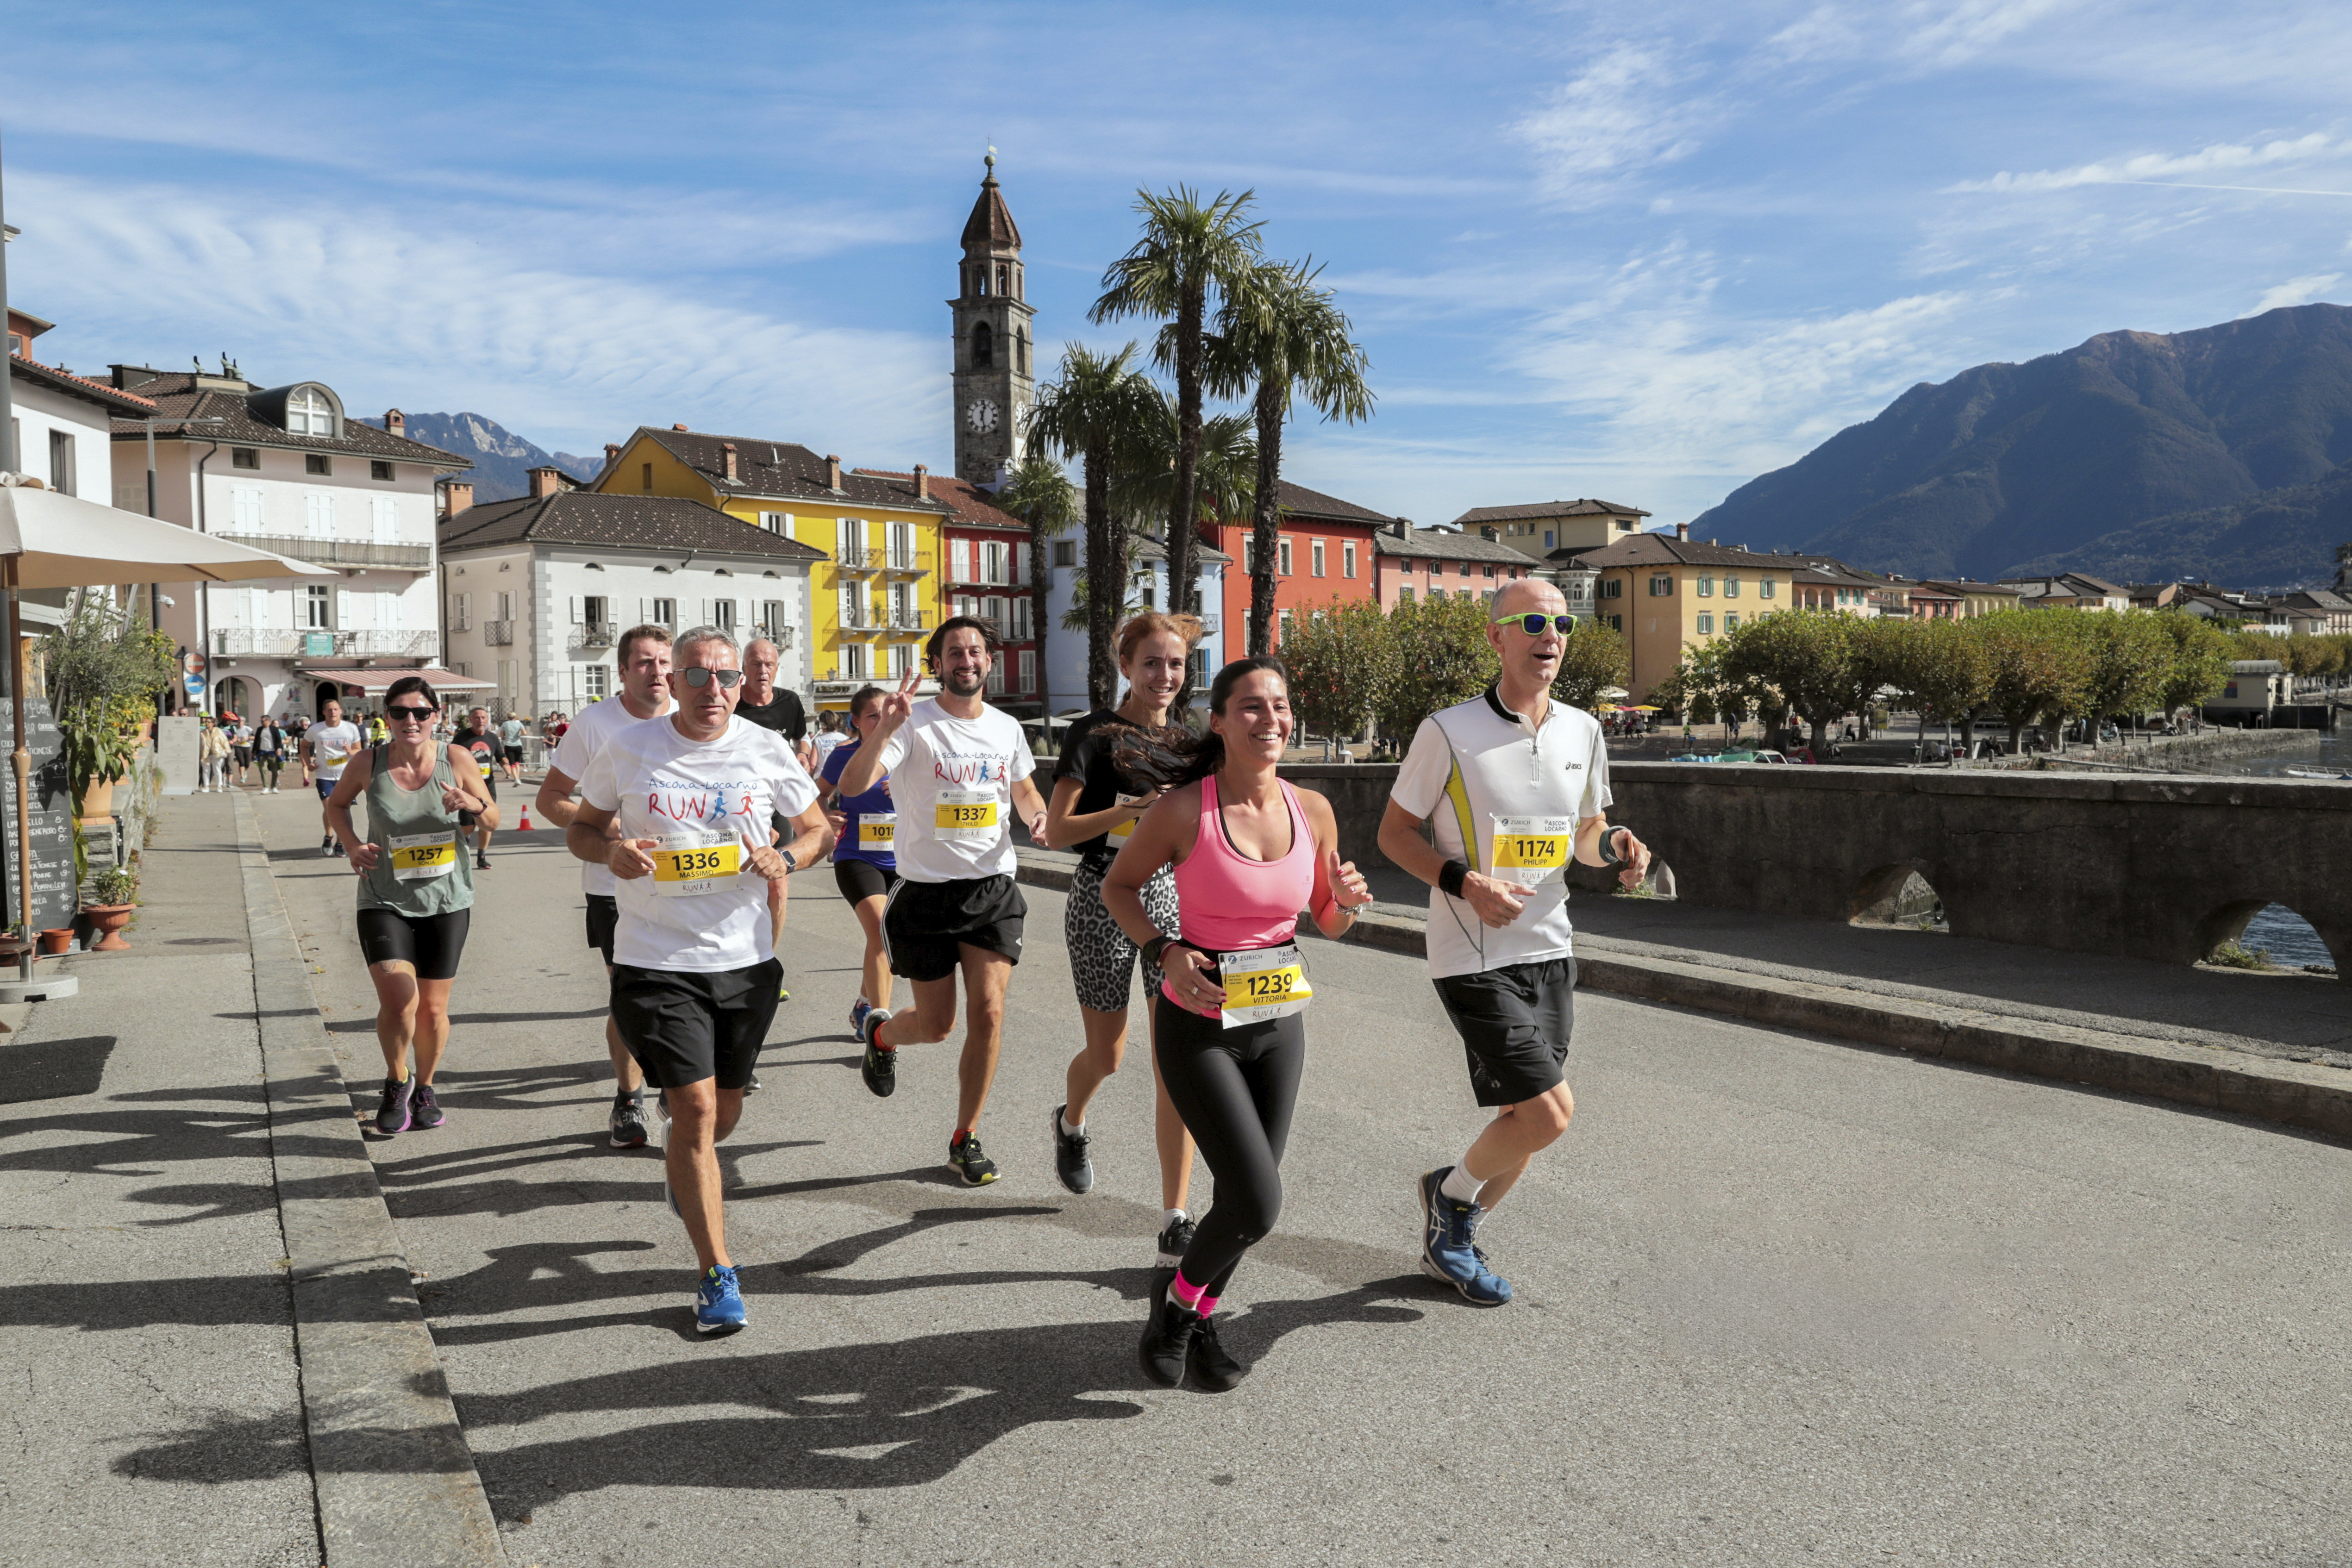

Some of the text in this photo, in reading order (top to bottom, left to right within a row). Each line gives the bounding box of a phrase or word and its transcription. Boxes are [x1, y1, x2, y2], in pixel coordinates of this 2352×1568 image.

[934, 750, 1009, 760] Ascona-Locarno
[935, 762, 976, 784] RUN
[648, 778, 757, 790] Ascona-Locarno
[28, 801, 43, 810] ATER
[649, 792, 706, 820] RUN
[953, 807, 988, 821] 1337
[28, 827, 57, 836] GENEROSO
[409, 847, 443, 861] 1257
[1516, 840, 1555, 857] 1174
[672, 851, 720, 871] 1336
[679, 869, 714, 878] MASSIMO
[1522, 872, 1536, 881] RUN
[682, 883, 698, 892] RUN
[1247, 973, 1293, 996] 1239
[1253, 994, 1287, 1004] VITTORIA
[1252, 1008, 1269, 1018] RUN
